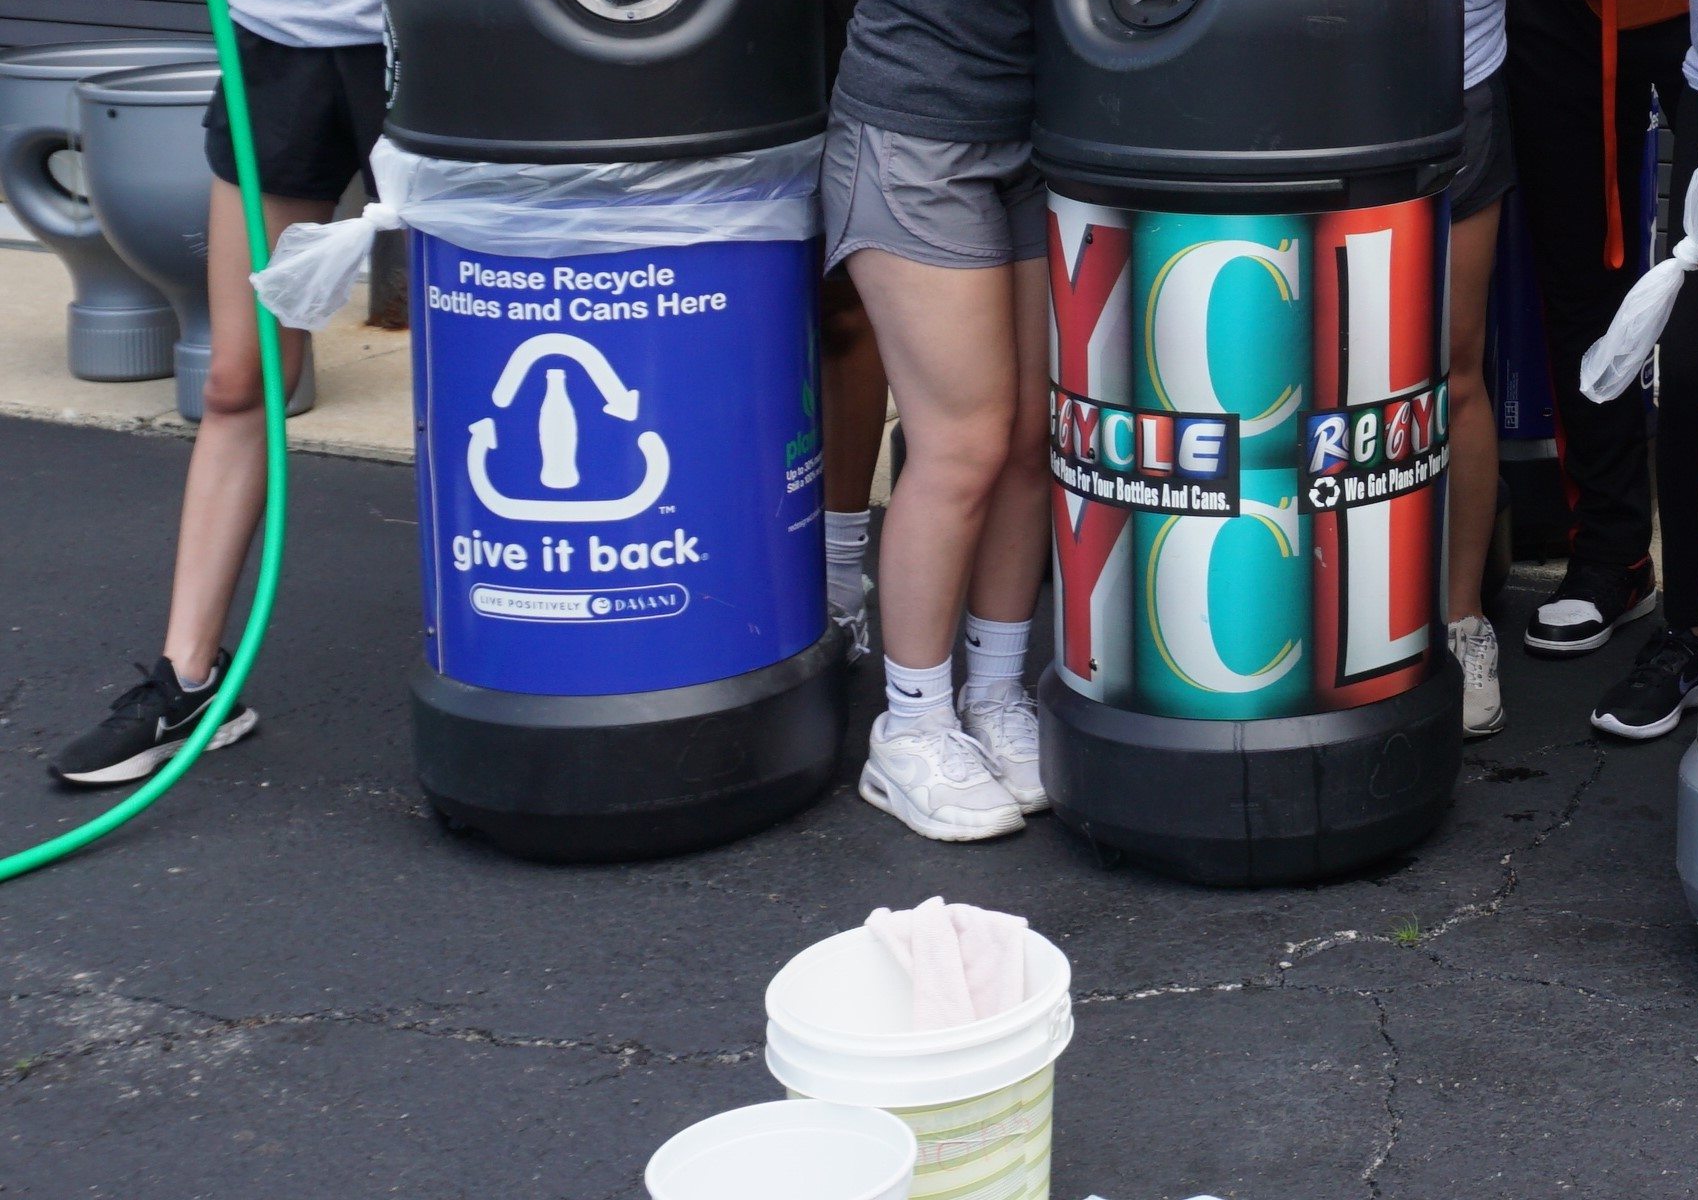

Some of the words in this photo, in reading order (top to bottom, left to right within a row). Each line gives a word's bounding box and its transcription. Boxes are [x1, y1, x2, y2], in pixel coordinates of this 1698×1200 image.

[459, 261, 546, 291] Please
[553, 263, 675, 295] Recycle
[429, 286, 502, 319] Bottles
[507, 298, 562, 322] and
[568, 297, 649, 322] Cans
[657, 291, 728, 317] Here
[1077, 465, 1091, 493] For
[1091, 470, 1115, 499] Your
[1116, 477, 1159, 507] Bottles
[1161, 483, 1188, 509] And
[1191, 485, 1231, 511] Cans.
[1344, 476, 1365, 501] We
[1367, 473, 1388, 498] Got
[1389, 467, 1414, 493] Plans
[1415, 460, 1428, 484] For
[1428, 453, 1442, 477] Your
[453, 529, 527, 571] give
[542, 535, 574, 573] it
[480, 595, 503, 607] LIVE
[507, 598, 580, 612] POSITIVELY
[615, 594, 677, 612] DASANI
